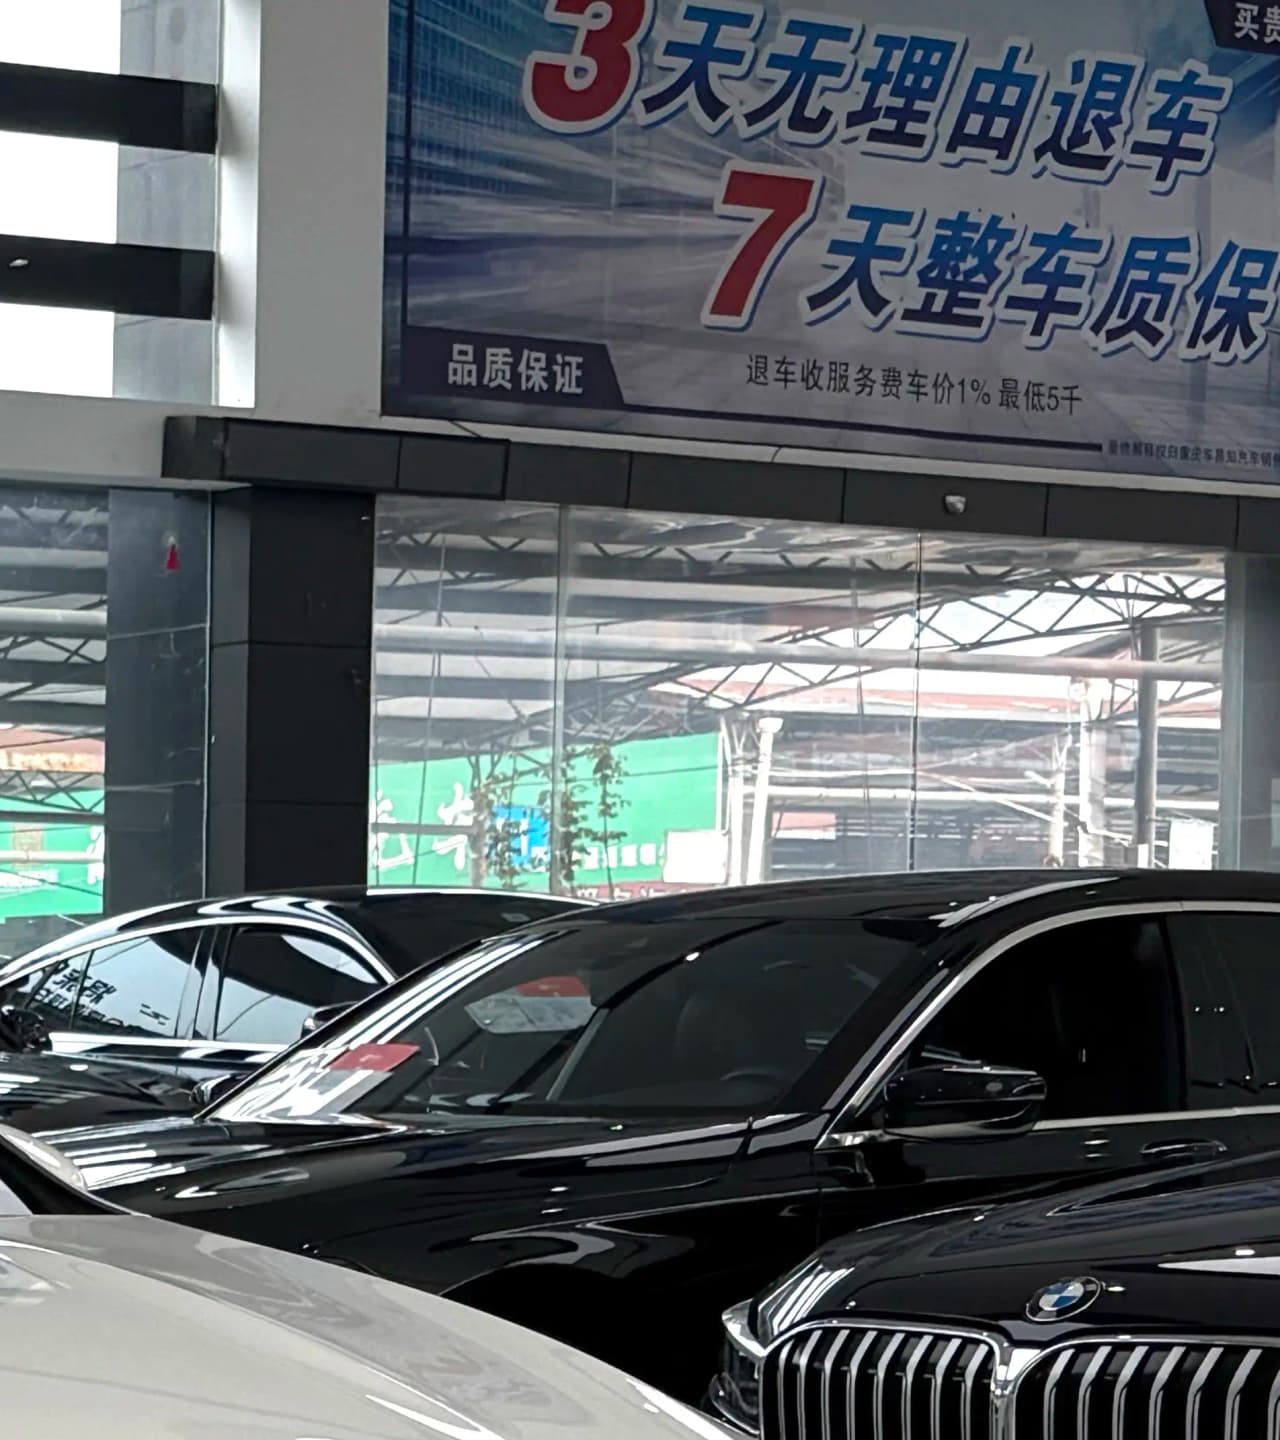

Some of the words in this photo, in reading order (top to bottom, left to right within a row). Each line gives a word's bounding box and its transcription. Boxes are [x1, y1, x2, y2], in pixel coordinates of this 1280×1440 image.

[526, 0, 1228, 184] 3天无理由退车
[706, 169, 1278, 353] 7天整车质保
[448, 343, 583, 394] 品质保证
